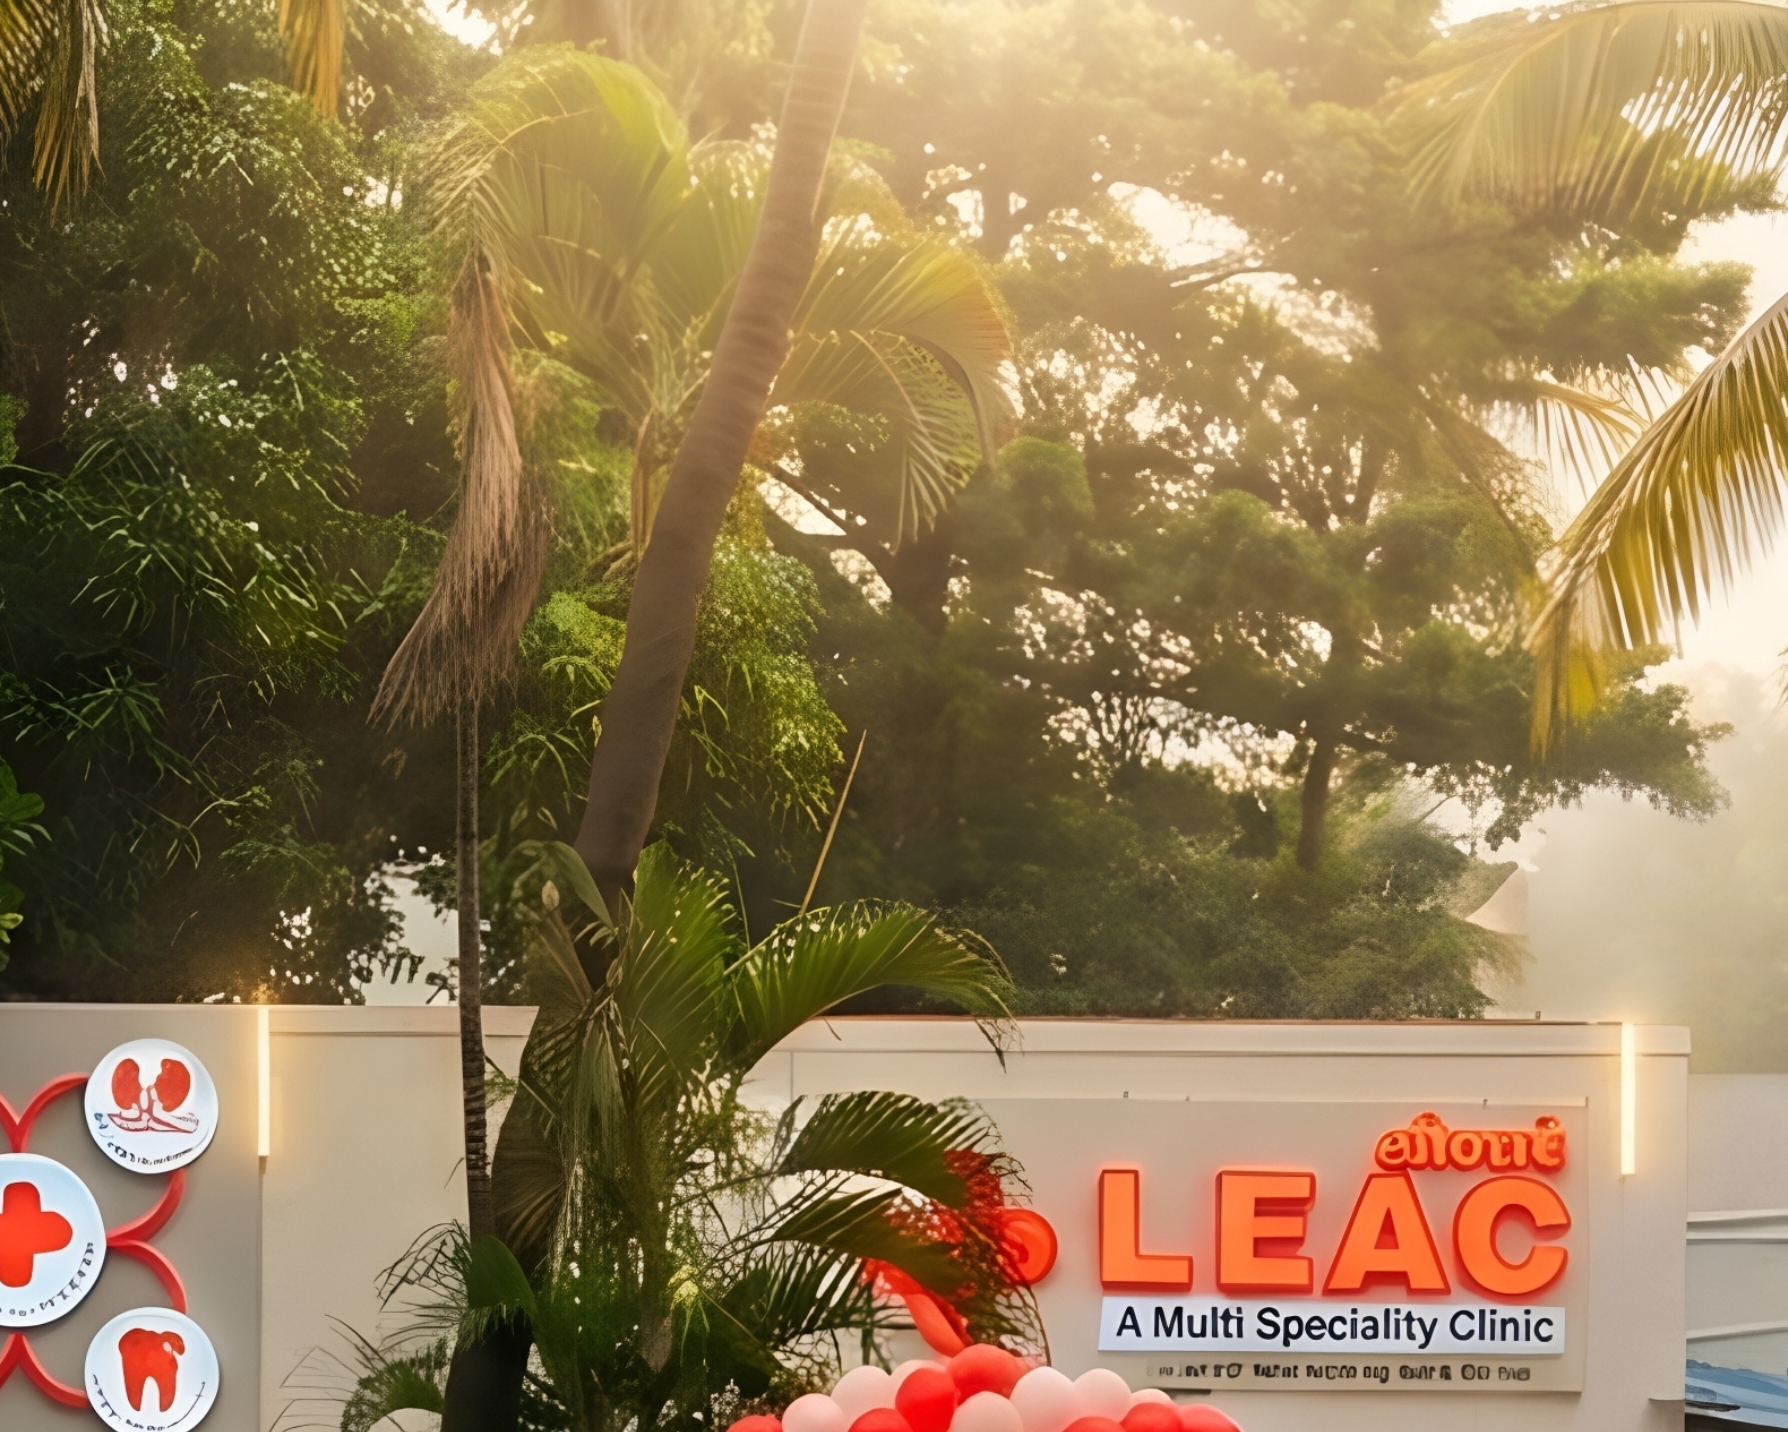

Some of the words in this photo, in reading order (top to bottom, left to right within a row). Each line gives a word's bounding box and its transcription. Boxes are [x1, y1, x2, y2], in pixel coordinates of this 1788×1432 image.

[1098, 1168, 1572, 1297] LEAC
[1116, 1306, 1143, 1338] A
[1153, 1306, 1244, 1340] Multi
[1256, 1307, 1439, 1349] Speciality
[1449, 1308, 1554, 1343] Clinic
